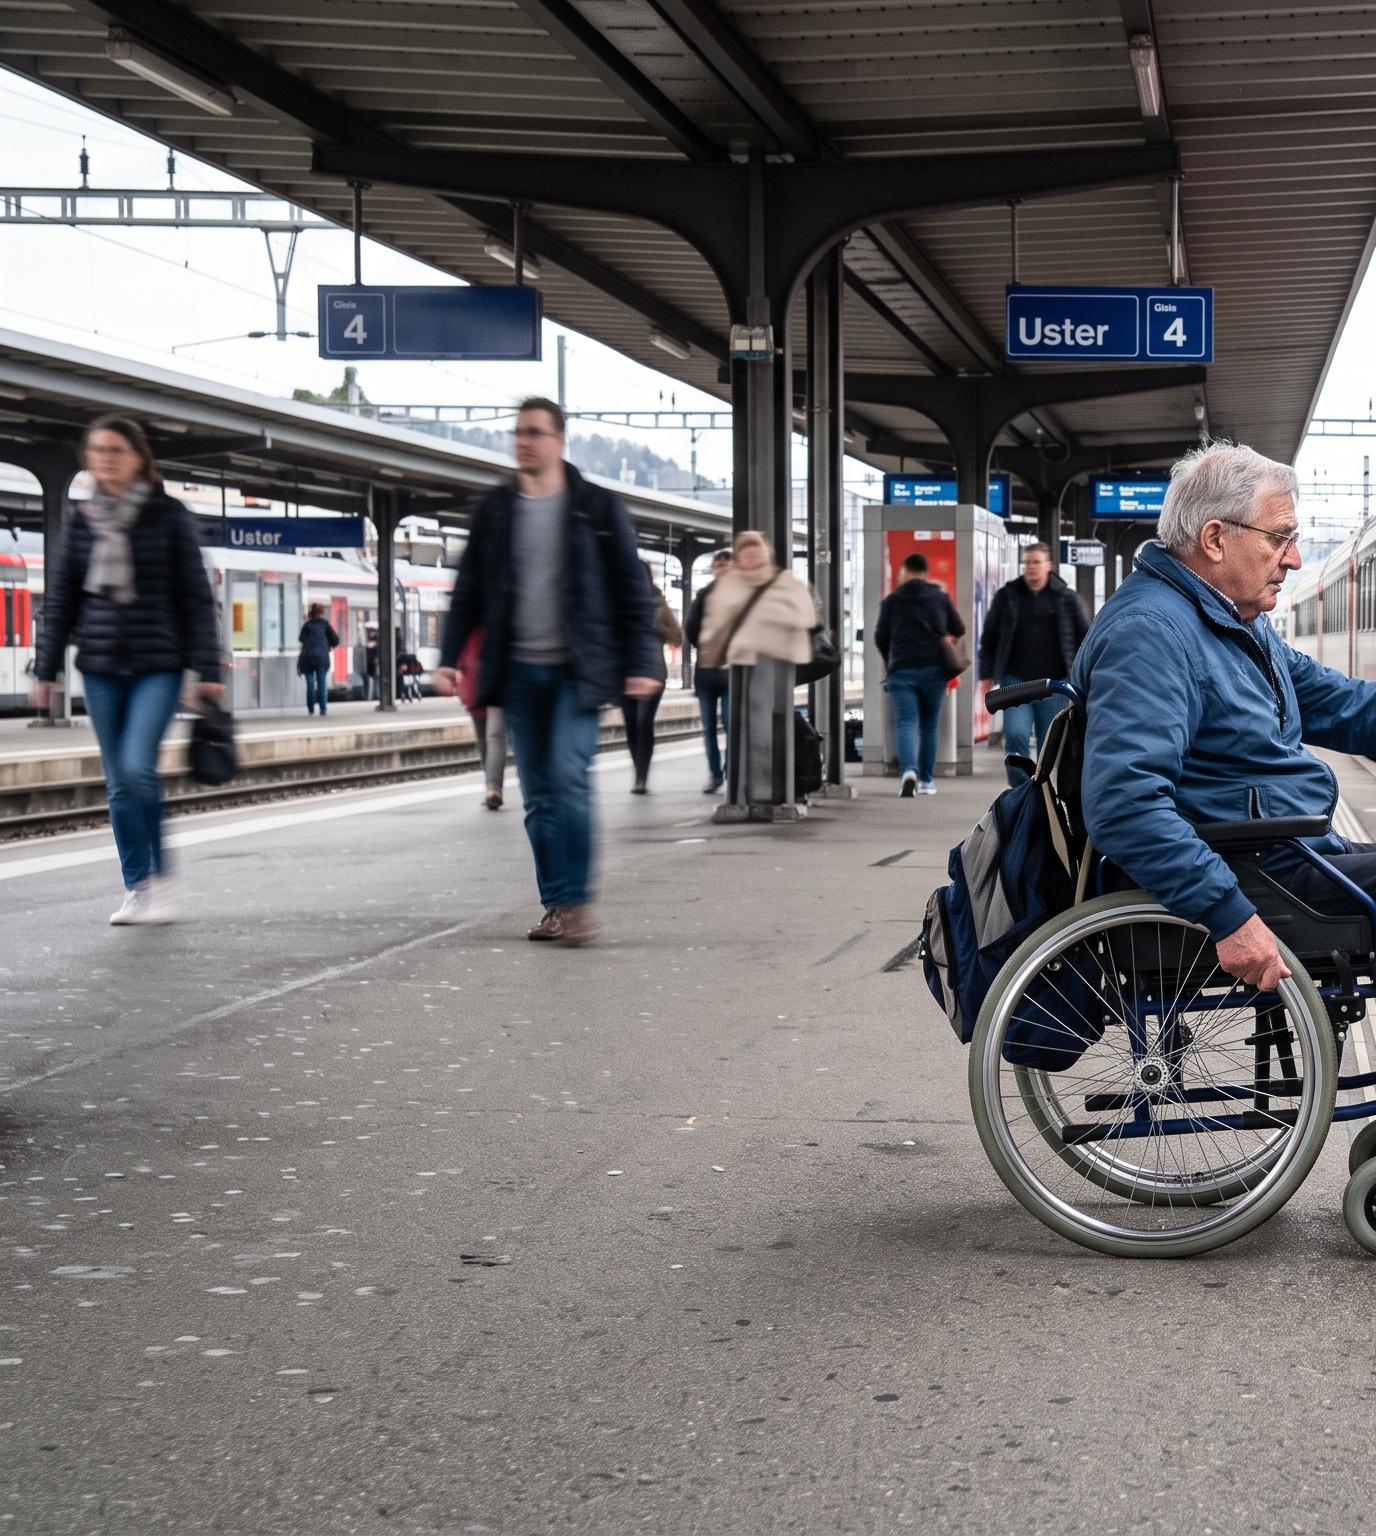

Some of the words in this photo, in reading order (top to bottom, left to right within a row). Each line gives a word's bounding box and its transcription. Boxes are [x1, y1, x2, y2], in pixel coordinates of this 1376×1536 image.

[343, 314, 367, 345] 4
[1019, 317, 1109, 346] Uster
[1163, 317, 1187, 347] 4
[230, 529, 282, 545] Uster
